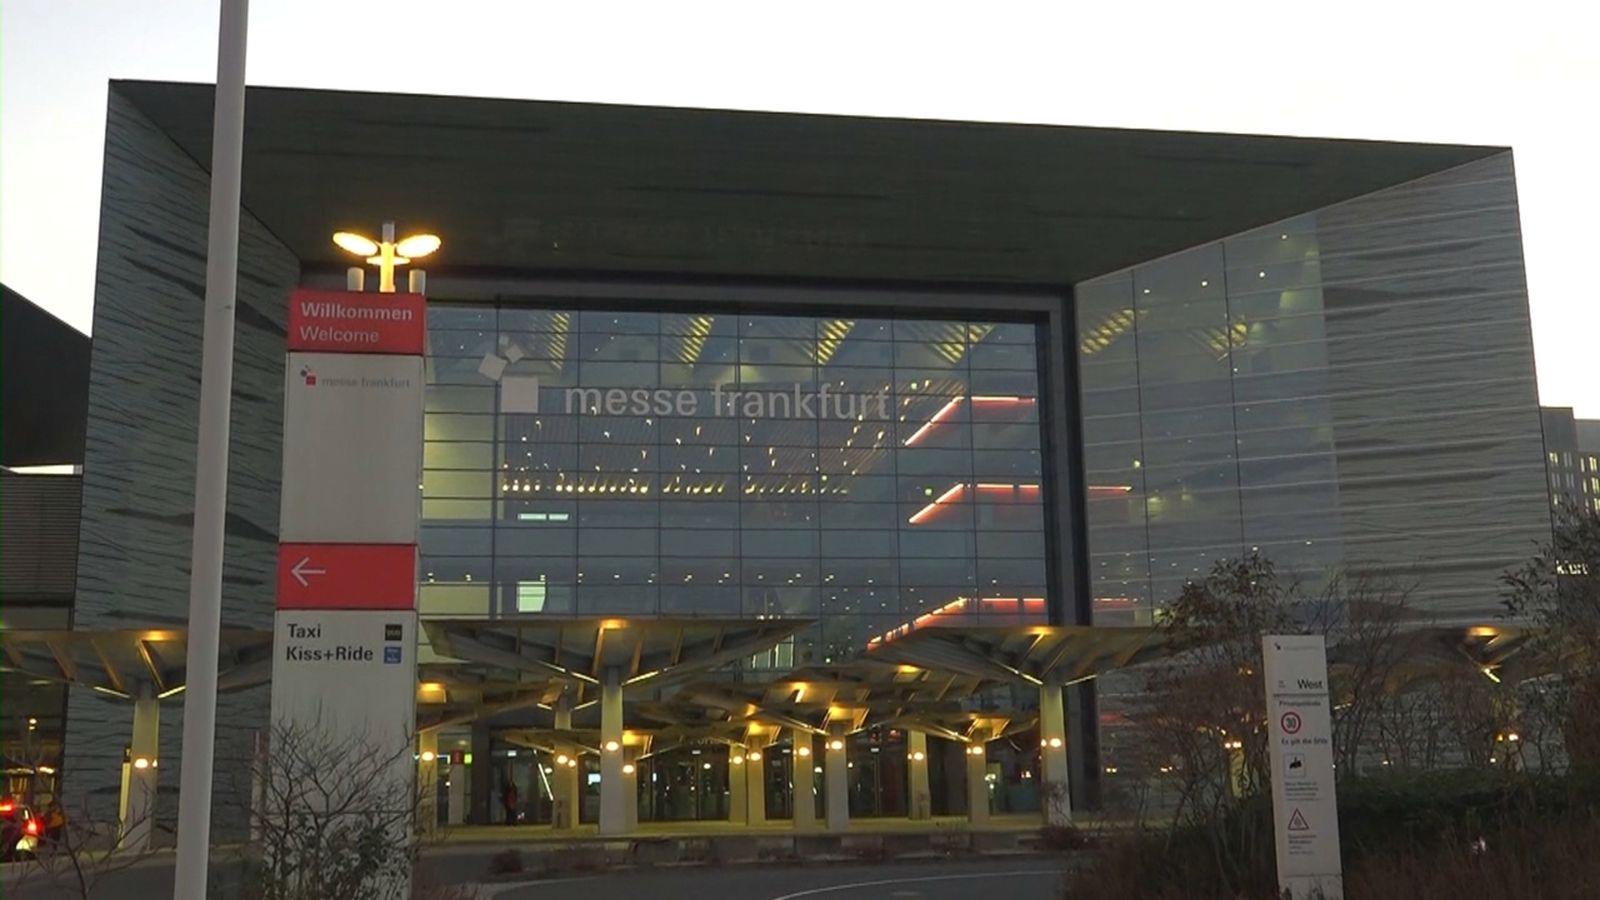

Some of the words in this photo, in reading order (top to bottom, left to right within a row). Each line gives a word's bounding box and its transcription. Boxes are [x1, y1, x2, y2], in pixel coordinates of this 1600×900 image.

[301, 302, 412, 321] Willkommen
[300, 325, 379, 343] Welcome
[361, 376, 410, 388] frankfurt
[564, 387, 698, 417] messe
[712, 382, 890, 421] frankfurt
[287, 623, 321, 638] Taxi
[286, 646, 373, 661] Kiss+Ride
[1297, 679, 1322, 689] West
